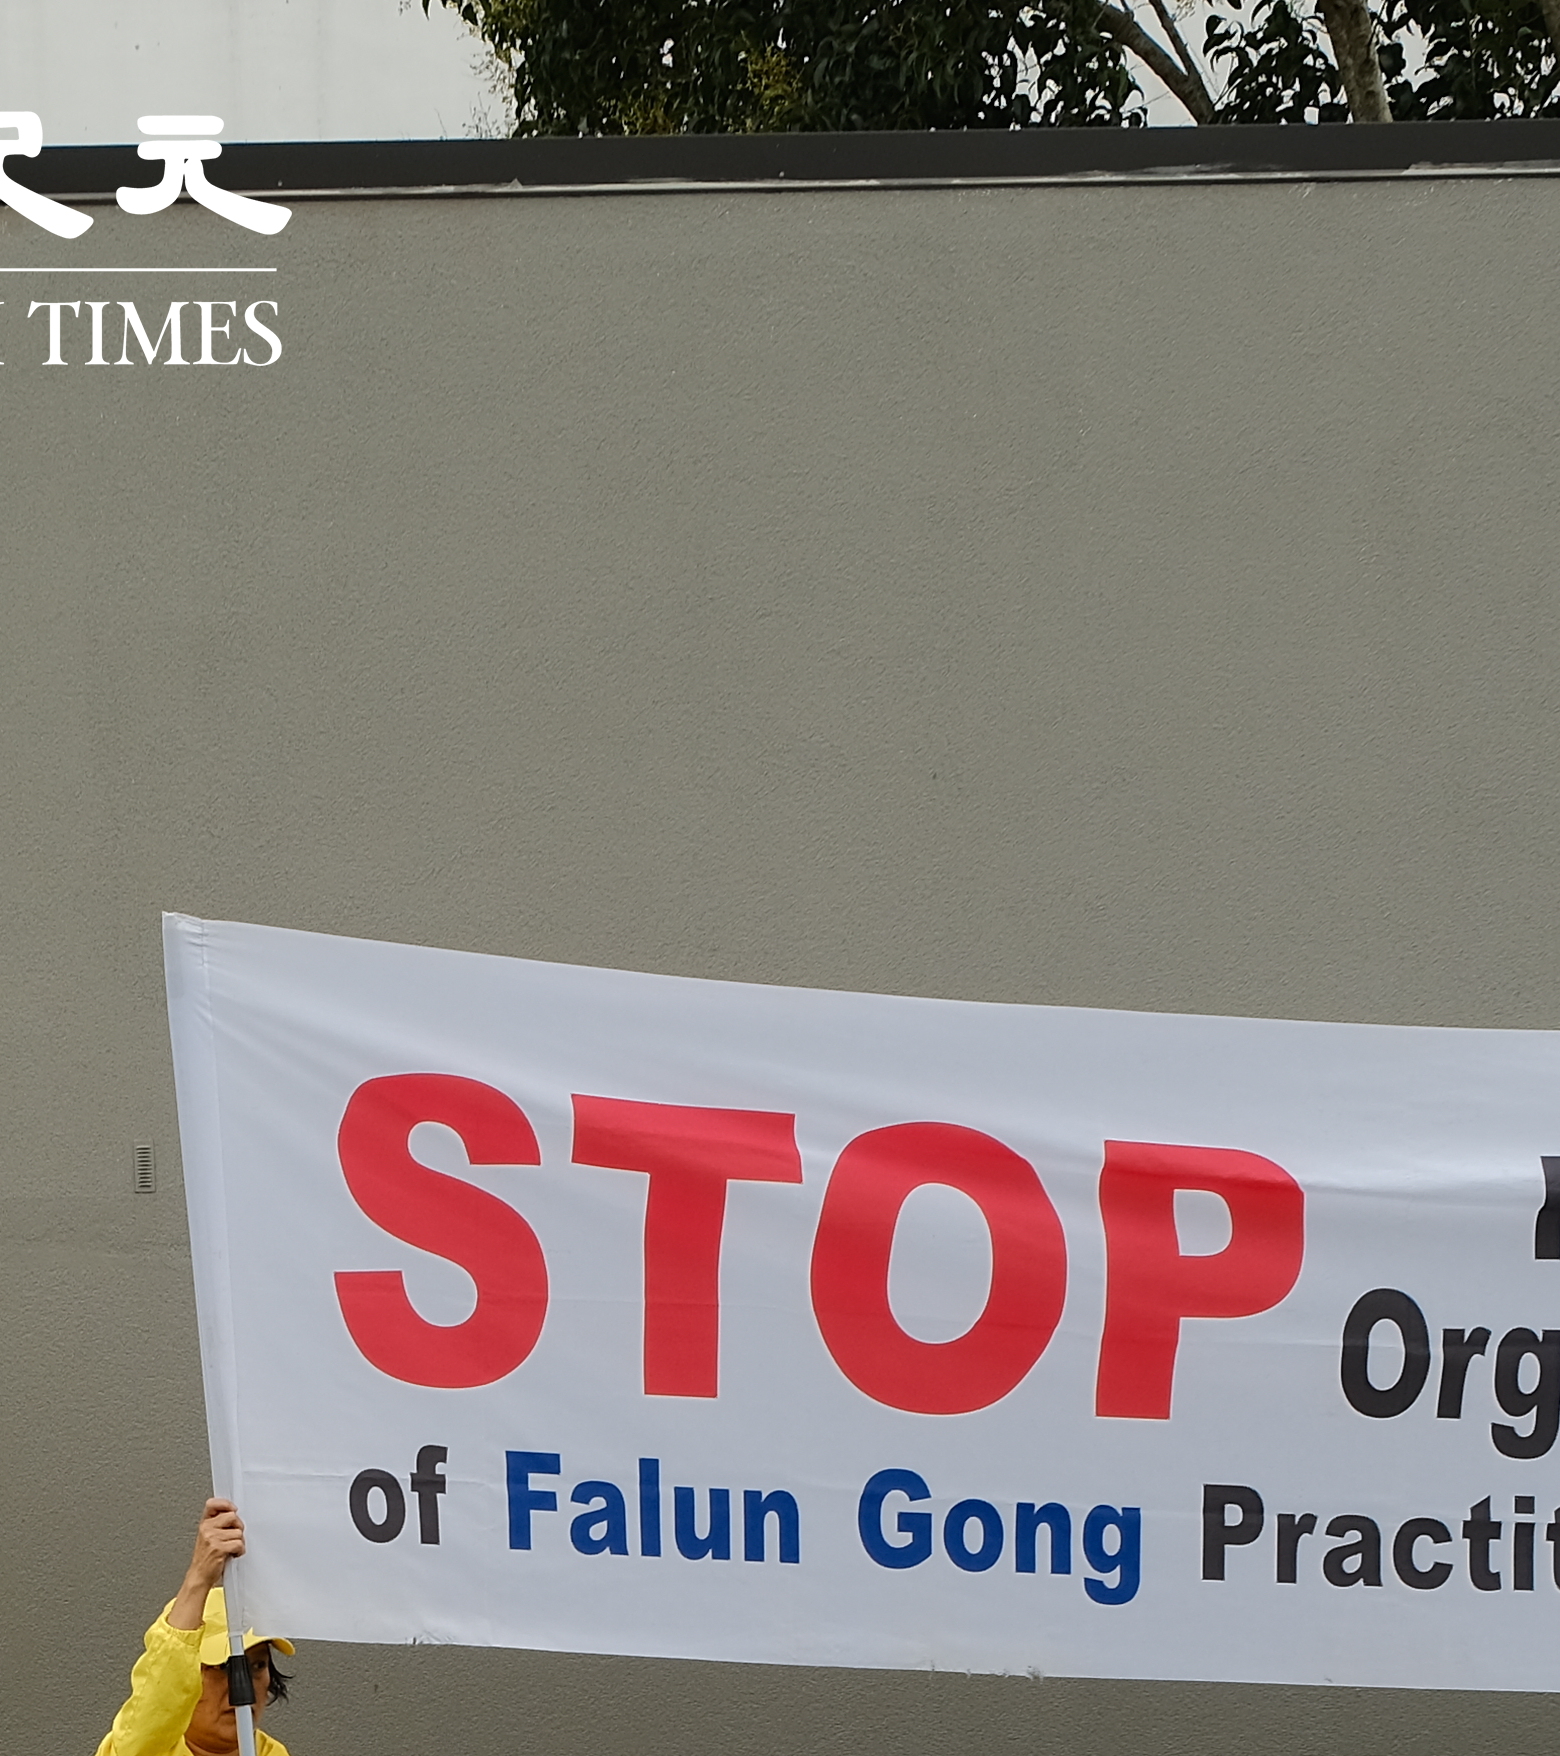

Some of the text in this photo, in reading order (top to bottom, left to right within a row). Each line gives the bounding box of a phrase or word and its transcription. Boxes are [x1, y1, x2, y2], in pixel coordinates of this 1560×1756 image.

[335, 1074, 1304, 1419] STOP
[350, 1445, 447, 1545] of
[507, 1451, 799, 1563] Falun
[859, 1469, 1141, 1604] Gong
